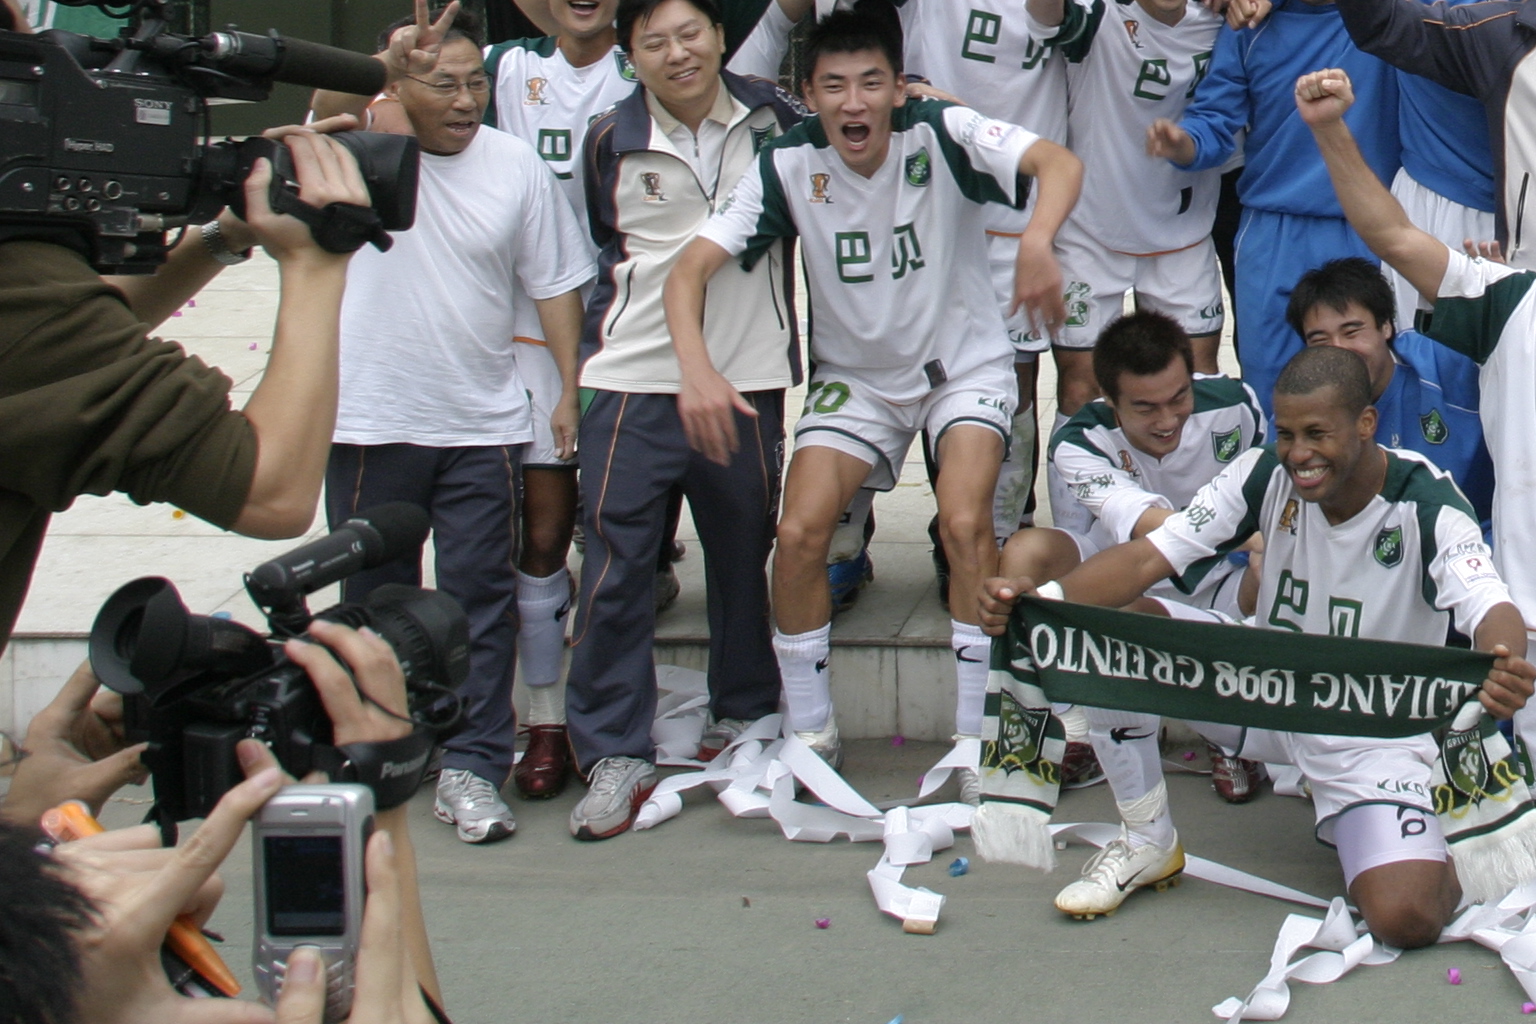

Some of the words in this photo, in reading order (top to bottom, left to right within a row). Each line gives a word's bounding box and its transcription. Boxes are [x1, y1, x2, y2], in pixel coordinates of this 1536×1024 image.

[134, 97, 173, 110] SONY
[835, 222, 926, 284] 巴贝
[1214, 660, 1297, 706] 1998
